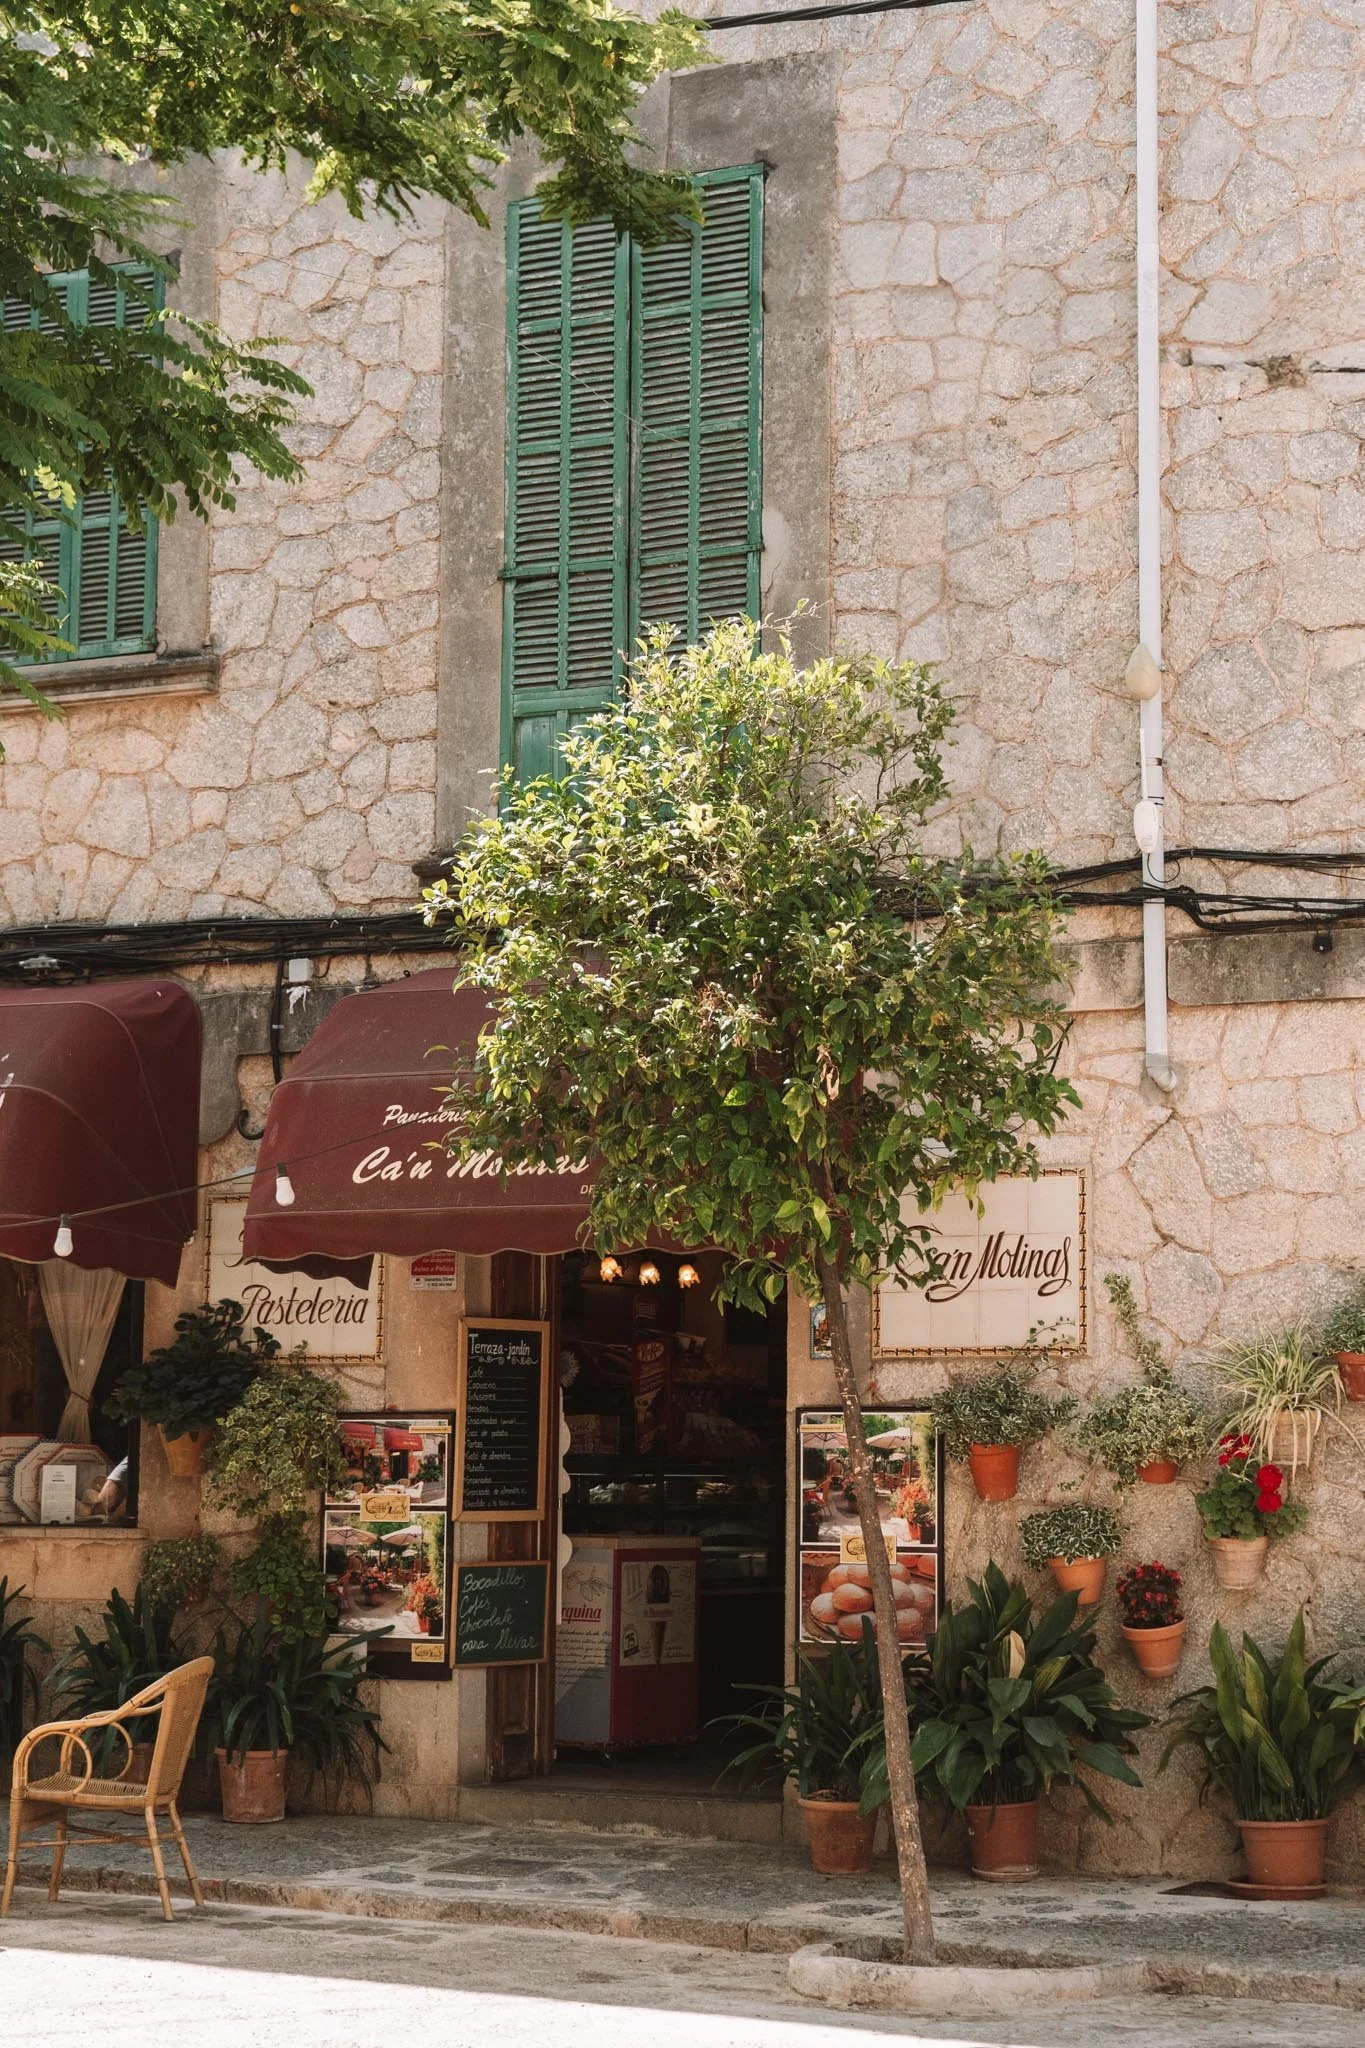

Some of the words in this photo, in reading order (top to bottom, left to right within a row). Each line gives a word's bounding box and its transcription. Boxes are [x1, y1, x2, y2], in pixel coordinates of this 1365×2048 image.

[352, 1146, 433, 1184] Ca'n
[925, 1231, 1072, 1303] Molinas
[236, 1284, 369, 1325] Pasteleria
